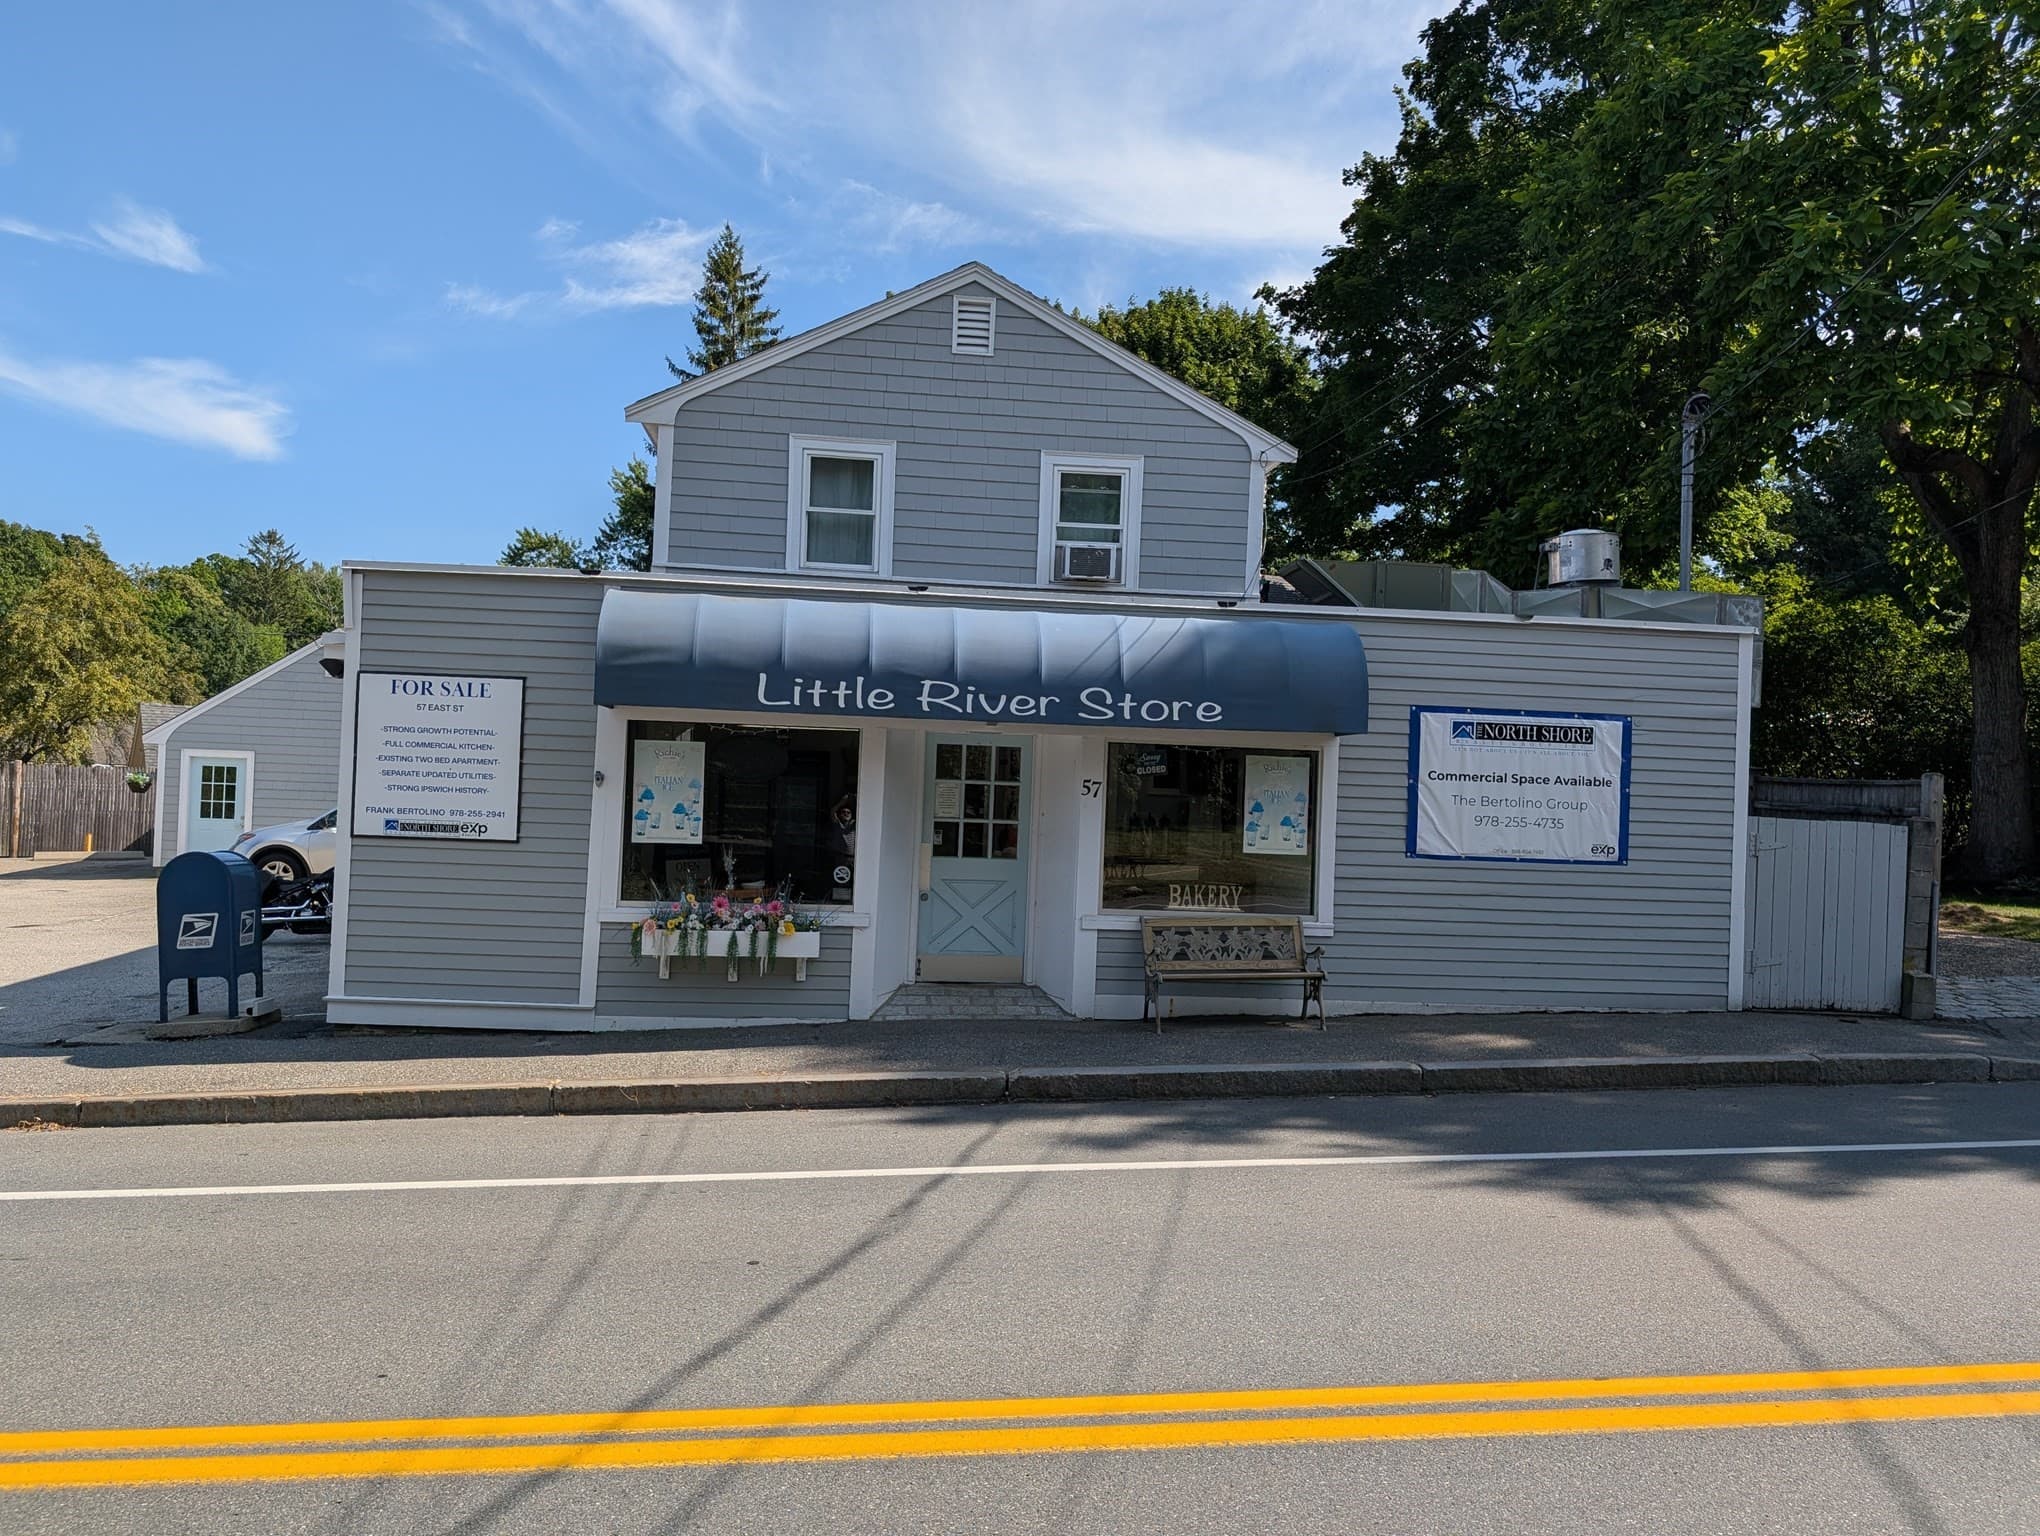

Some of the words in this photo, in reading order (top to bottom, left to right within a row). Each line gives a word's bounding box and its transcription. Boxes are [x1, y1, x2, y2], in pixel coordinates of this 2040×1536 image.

[391, 679, 435, 696] FOR
[440, 681, 492, 699] SALE
[757, 673, 896, 711] Little
[917, 679, 1060, 717] River
[1078, 687, 1224, 722] Store
[428, 704, 451, 712] EAST
[452, 704, 464, 713] ST
[380, 726, 416, 734] -STRONG
[417, 727, 452, 735] GROWTH
[453, 728, 498, 737] POTENTIAL-
[1484, 723, 1539, 741] NORTH
[1541, 727, 1592, 744] SHORE
[382, 740, 404, 748] -FULL
[405, 741, 458, 750] COMMERCIAL
[459, 743, 495, 751] KITCHEN-
[376, 755, 414, 763] -EXISTING
[415, 756, 434, 764] TWO
[434, 756, 451, 764] BED
[452, 757, 501, 766] APARTMENT-
[378, 770, 421, 778] -SEPARATE
[422, 770, 458, 779] UPDATED
[458, 772, 497, 780] UTILITIES-
[1136, 765, 1167, 776] CLOSED
[654, 776, 684, 786] ITALIAN
[1427, 770, 1509, 784] Commercial
[1511, 773, 1551, 788] Space
[1553, 775, 1613, 789] Available
[384, 784, 420, 793] -STRONG
[421, 785, 454, 793] IPSWICH
[455, 786, 490, 795] HISTORY-
[1080, 778, 1102, 798] 57
[1451, 795, 1477, 807] The
[1480, 796, 1543, 809] Bertolino
[1546, 799, 1589, 813] Group
[365, 806, 396, 815] FRANK
[396, 807, 446, 817] BERTOLINO
[449, 809, 506, 818] 978-255-2941
[1474, 815, 1565, 829] 978-255-4735
[1168, 883, 1243, 908] BAKERY
